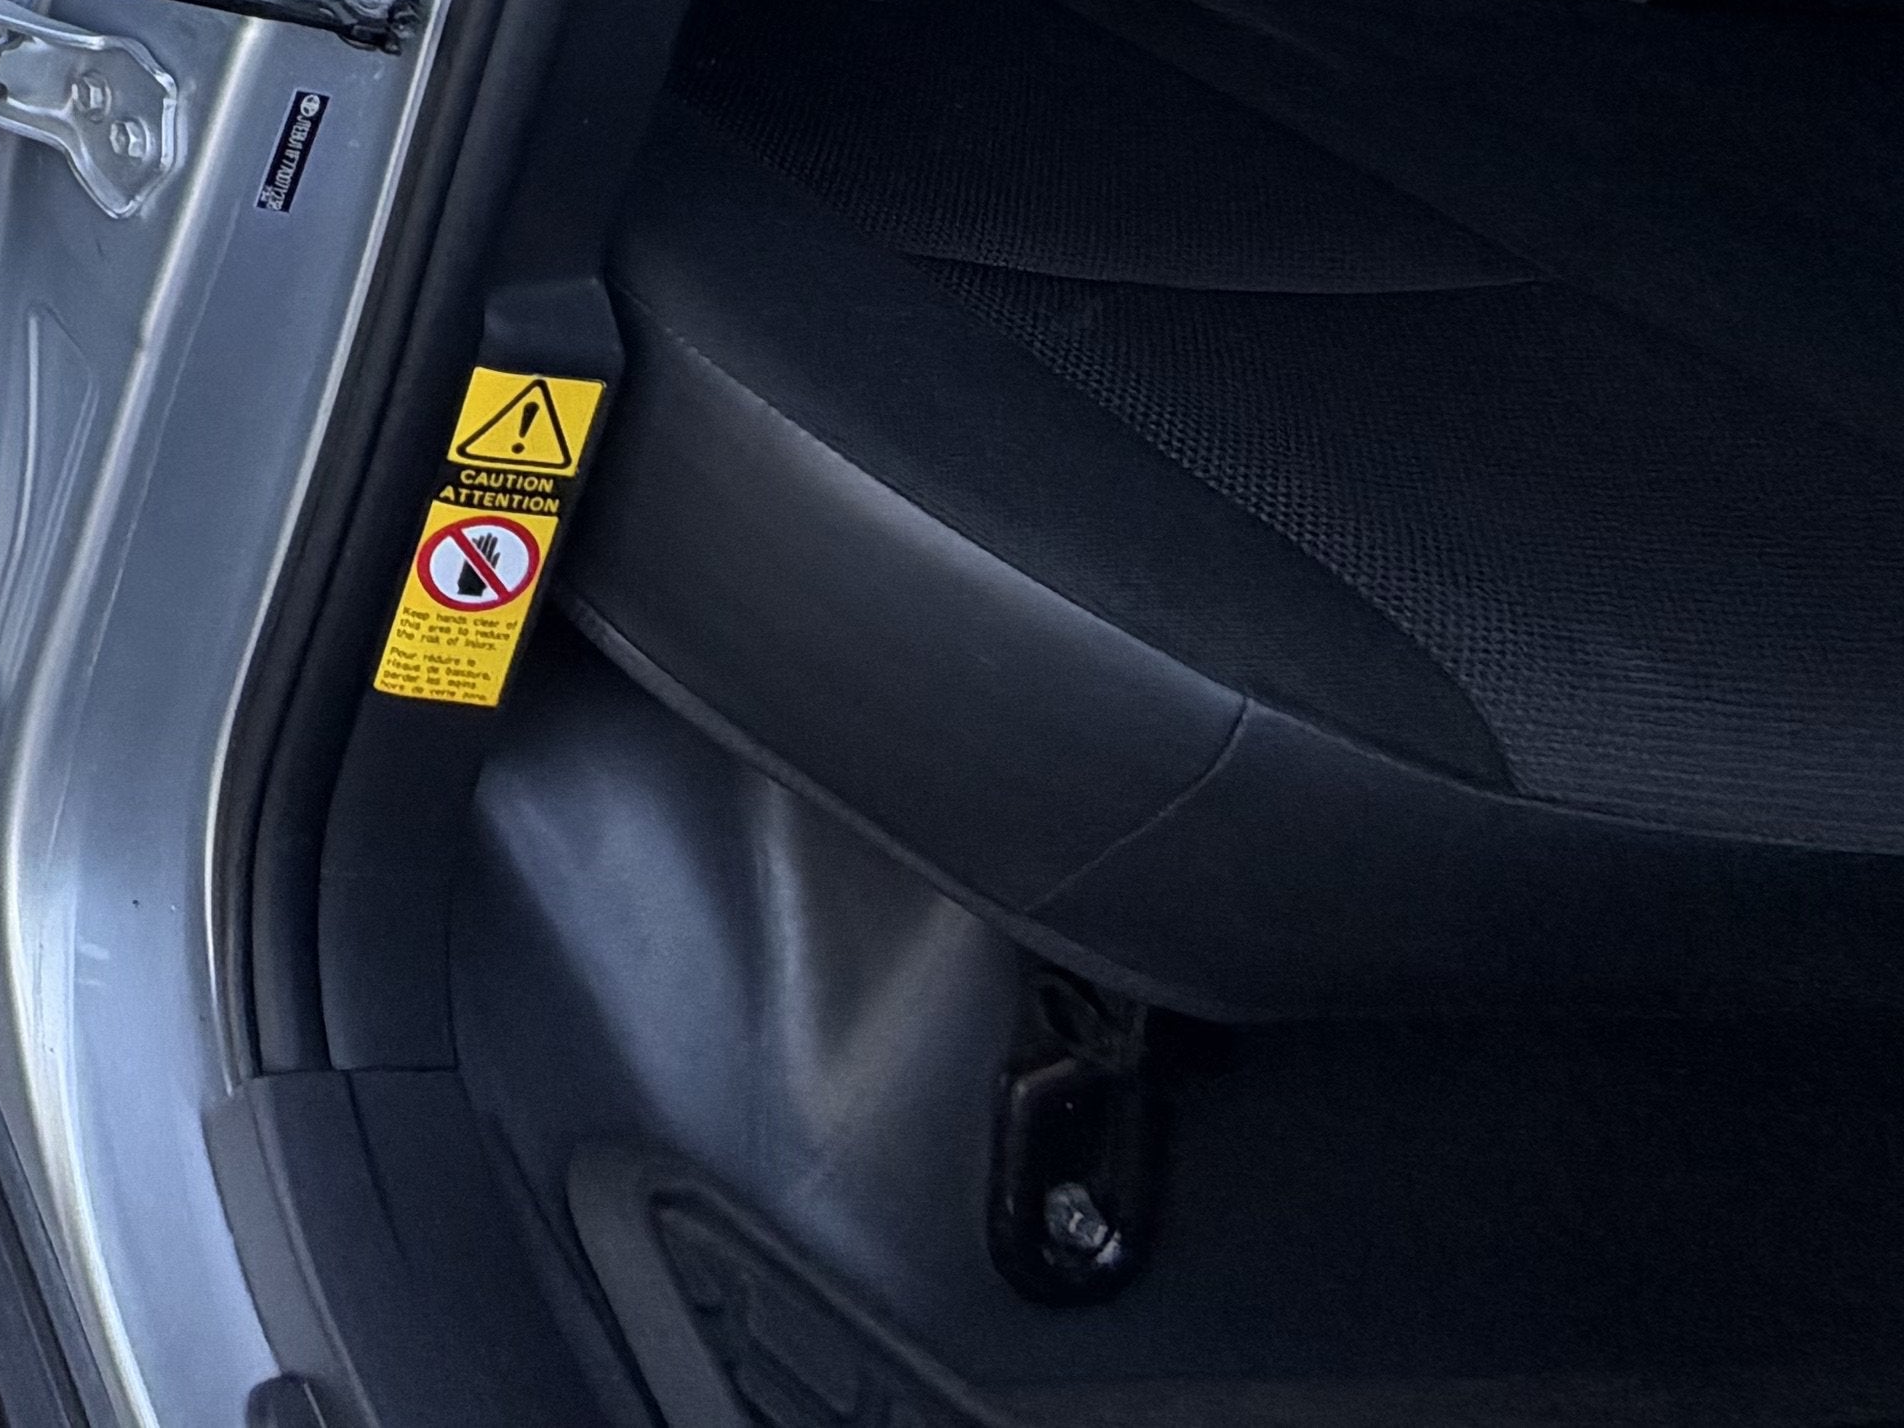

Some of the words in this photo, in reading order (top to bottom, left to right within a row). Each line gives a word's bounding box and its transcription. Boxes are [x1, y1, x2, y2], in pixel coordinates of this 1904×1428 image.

[459, 469, 554, 493] CAUTION
[438, 485, 560, 513] ATTENTION
[400, 618, 421, 631] this
[428, 625, 451, 634] area
[457, 627, 469, 636] to
[475, 629, 511, 641] reduce
[402, 606, 430, 621] Keep
[436, 613, 467, 625] hands
[473, 617, 500, 628] clear
[506, 620, 518, 630] of
[396, 629, 415, 640] the
[446, 636, 459, 646] of
